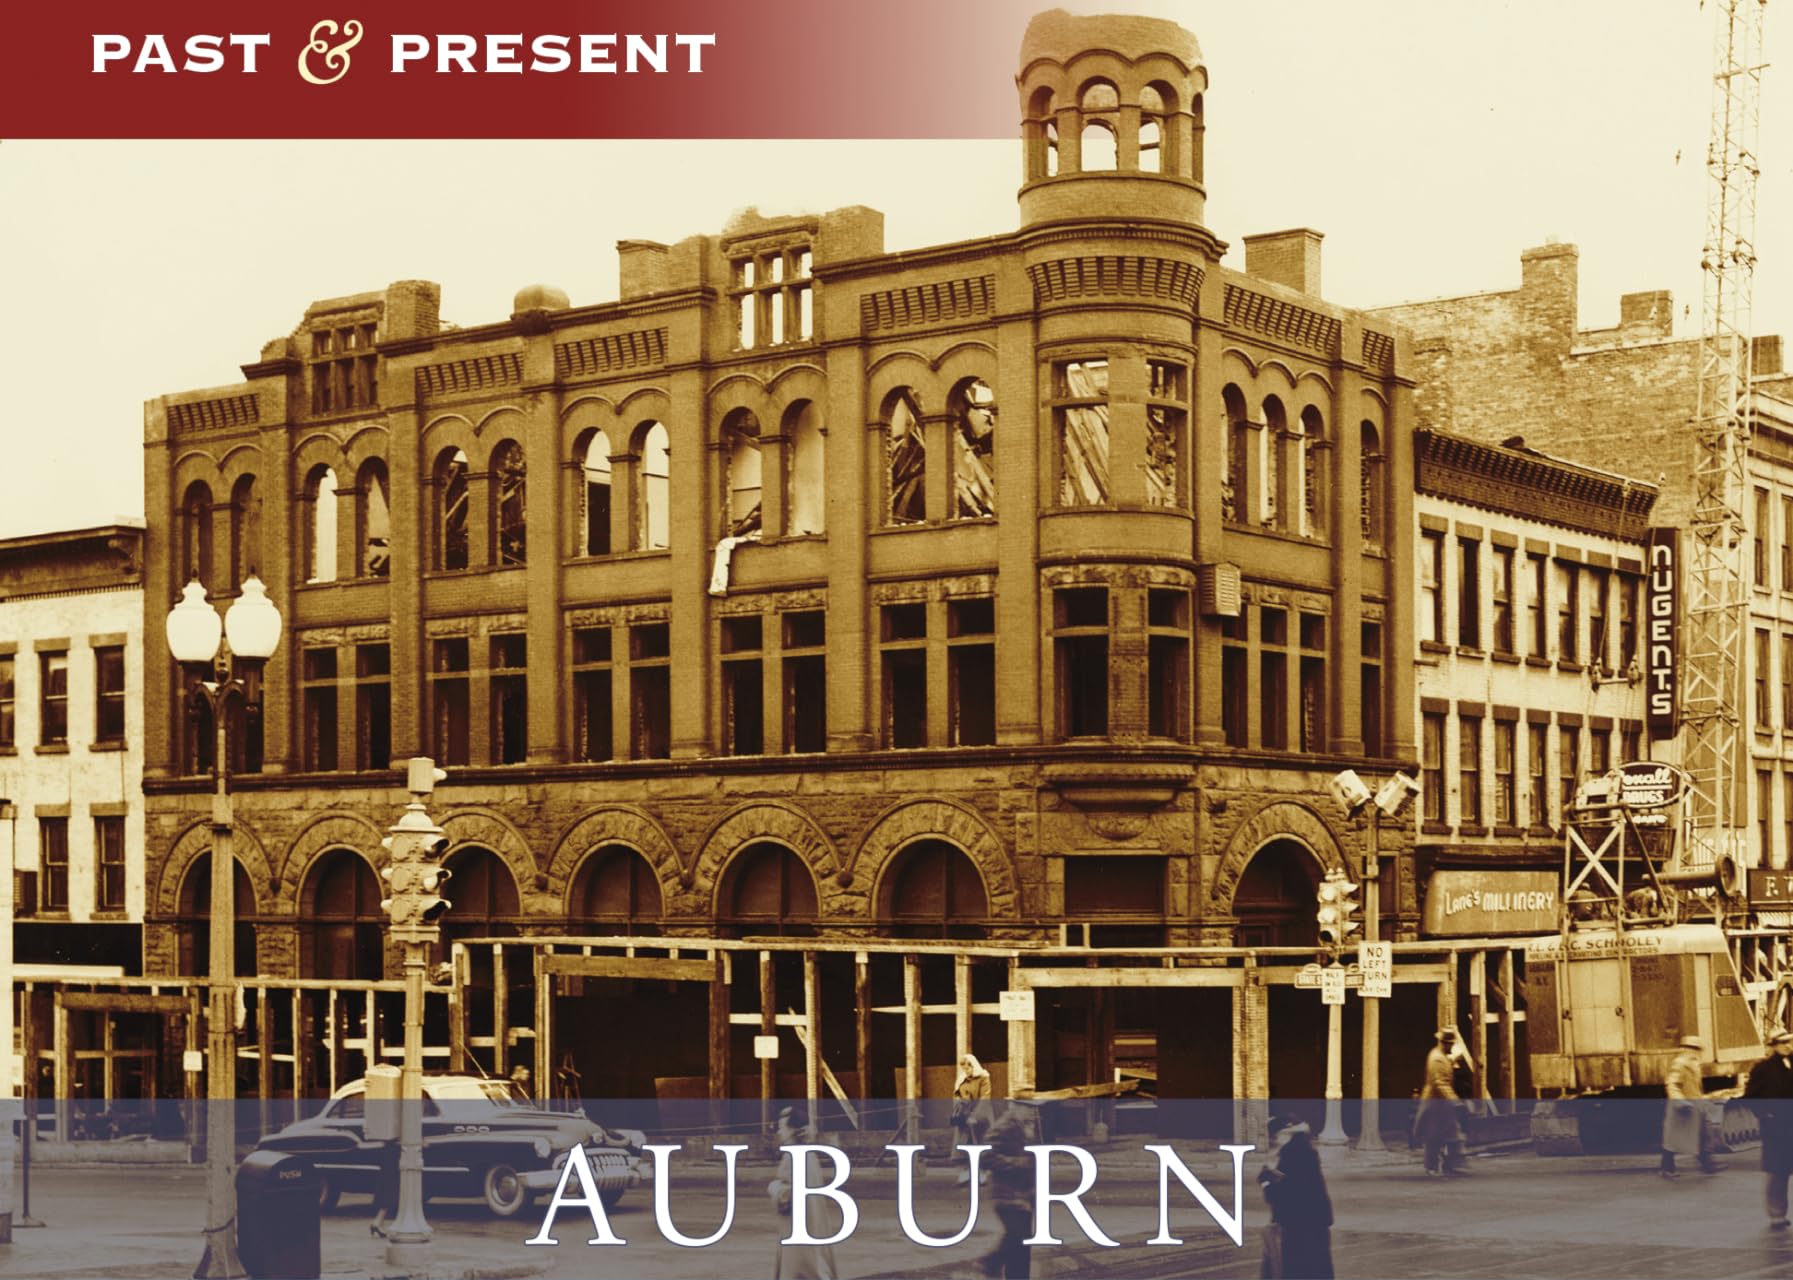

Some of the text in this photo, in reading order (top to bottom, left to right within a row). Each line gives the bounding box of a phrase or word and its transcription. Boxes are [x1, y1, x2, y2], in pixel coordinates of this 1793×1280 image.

[1622, 790, 1664, 804] DRUGS
[1367, 947, 1383, 957] NO
[1363, 960, 1387, 968] LEFT
[1363, 971, 1388, 981] TURN
